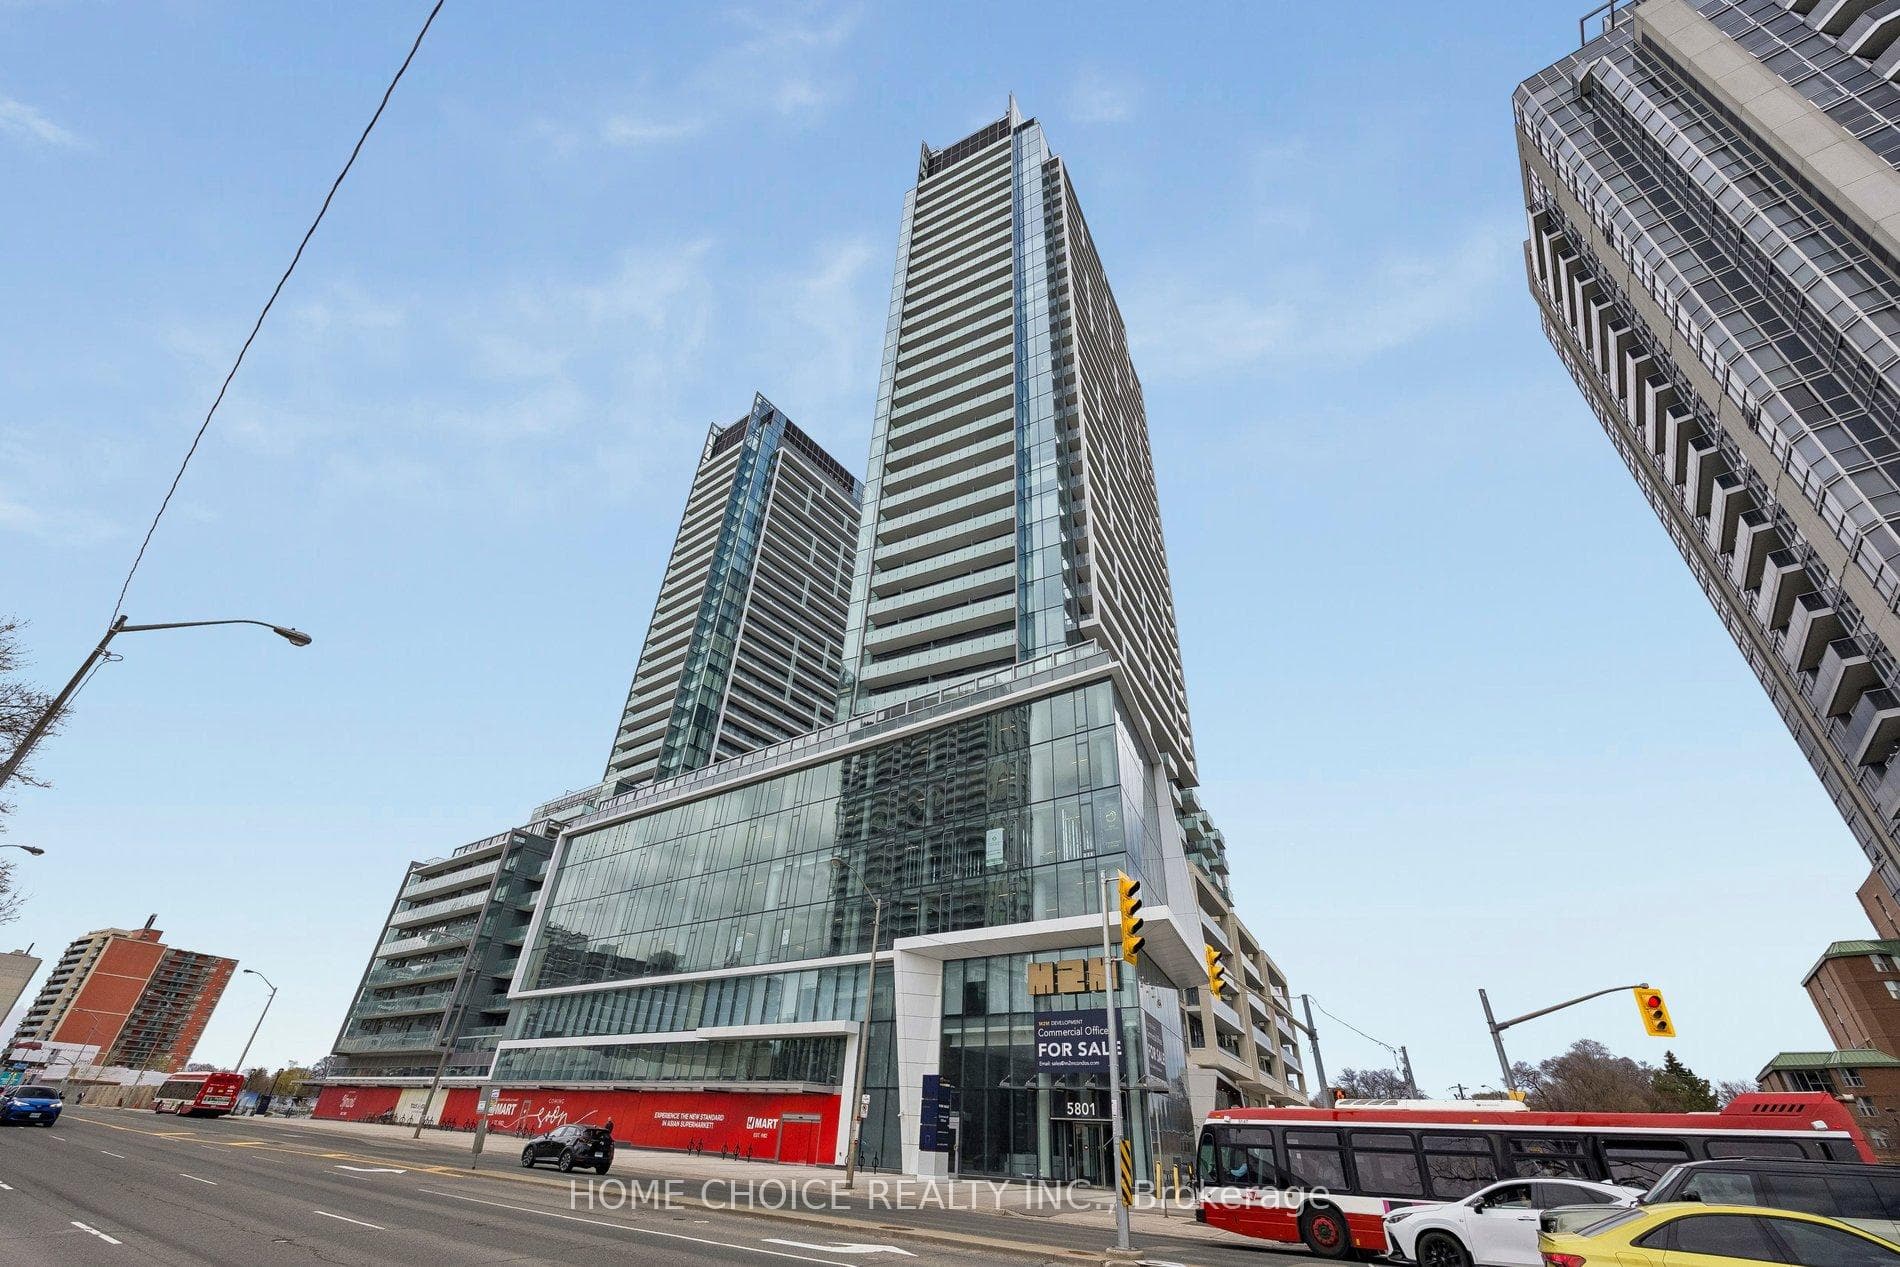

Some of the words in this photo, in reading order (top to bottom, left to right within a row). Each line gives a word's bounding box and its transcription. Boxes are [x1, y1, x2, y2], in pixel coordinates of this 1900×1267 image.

[1038, 1027, 1082, 1037] Commercial
[1038, 1042, 1073, 1057] FOR
[1066, 1102, 1096, 1116] 5801
[654, 1111, 681, 1119] EXPERIENCE
[681, 1112, 690, 1120] THE
[700, 1113, 725, 1121] STANDARD
